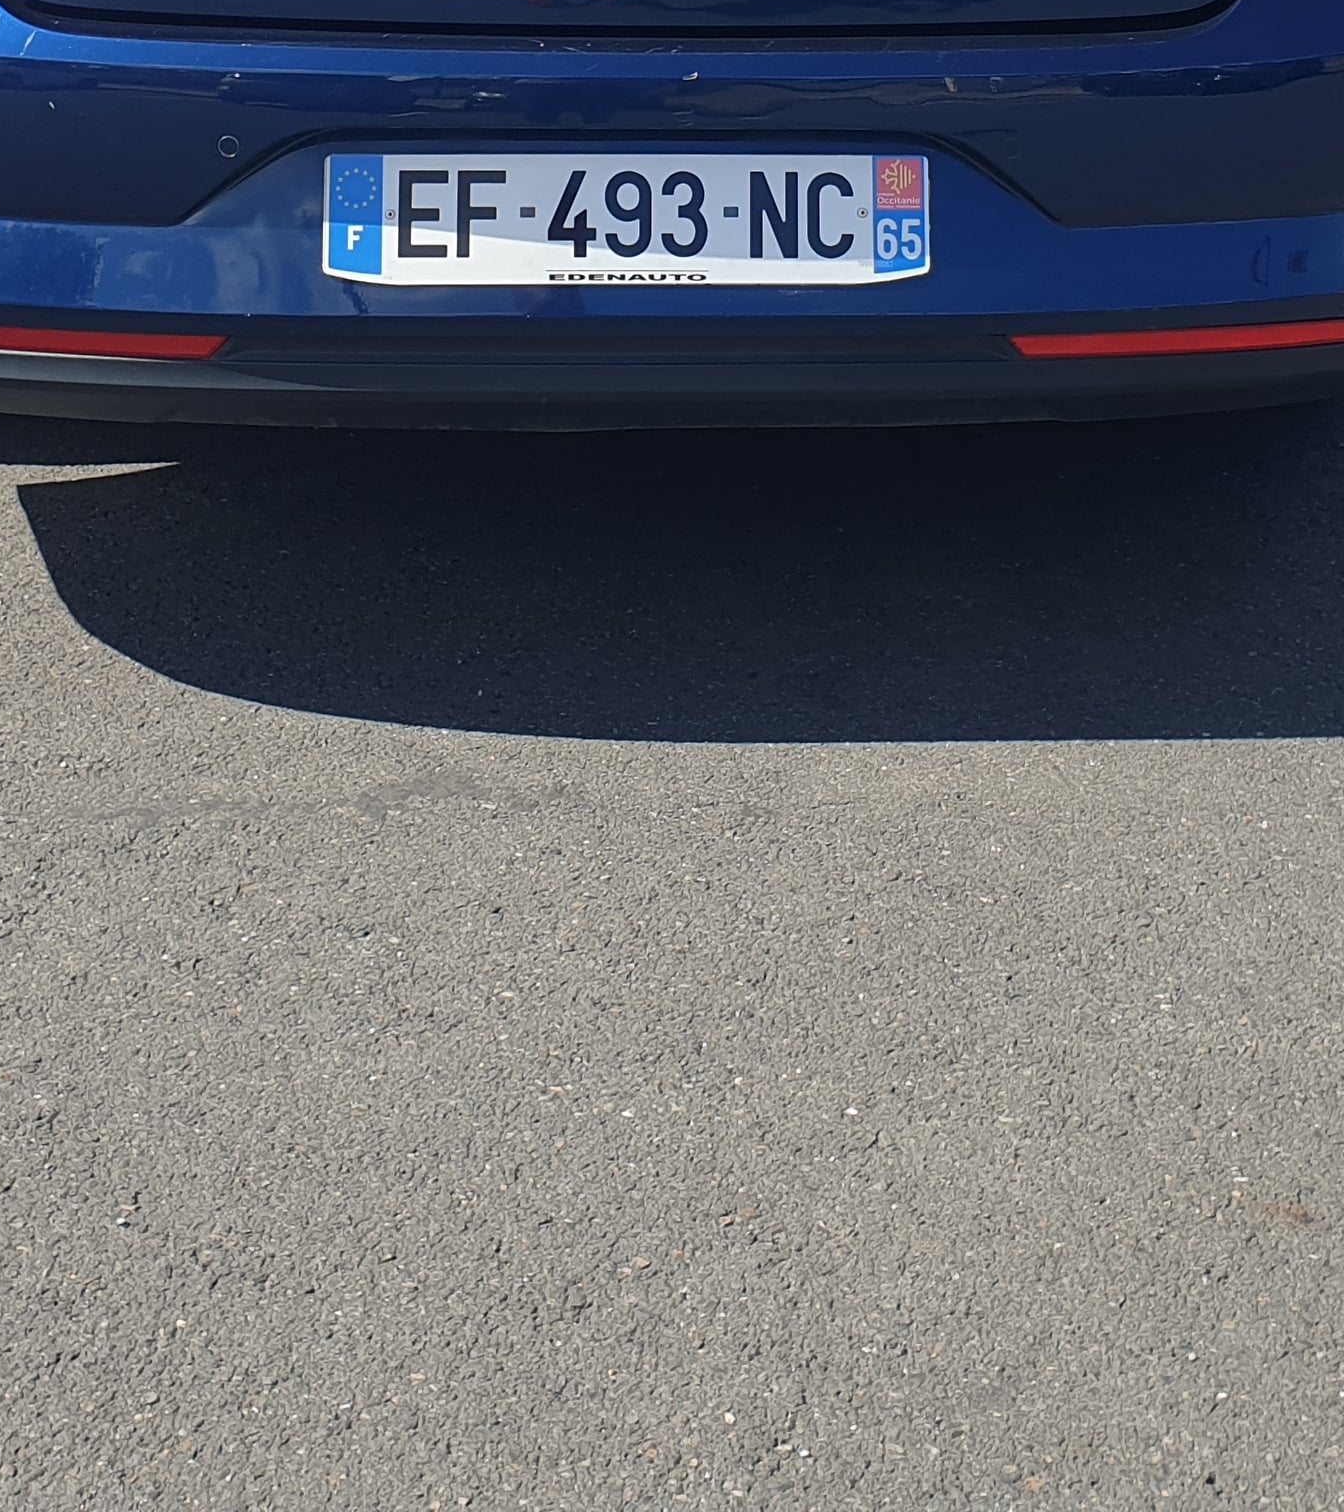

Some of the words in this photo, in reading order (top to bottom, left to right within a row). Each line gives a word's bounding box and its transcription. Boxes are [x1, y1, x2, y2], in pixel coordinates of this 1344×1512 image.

[877, 196, 921, 205] Occitanie
[397, 170, 855, 258] EF-493-NC
[347, 225, 364, 250] F
[877, 218, 922, 260] 65
[548, 273, 708, 281] EDENAUTO
